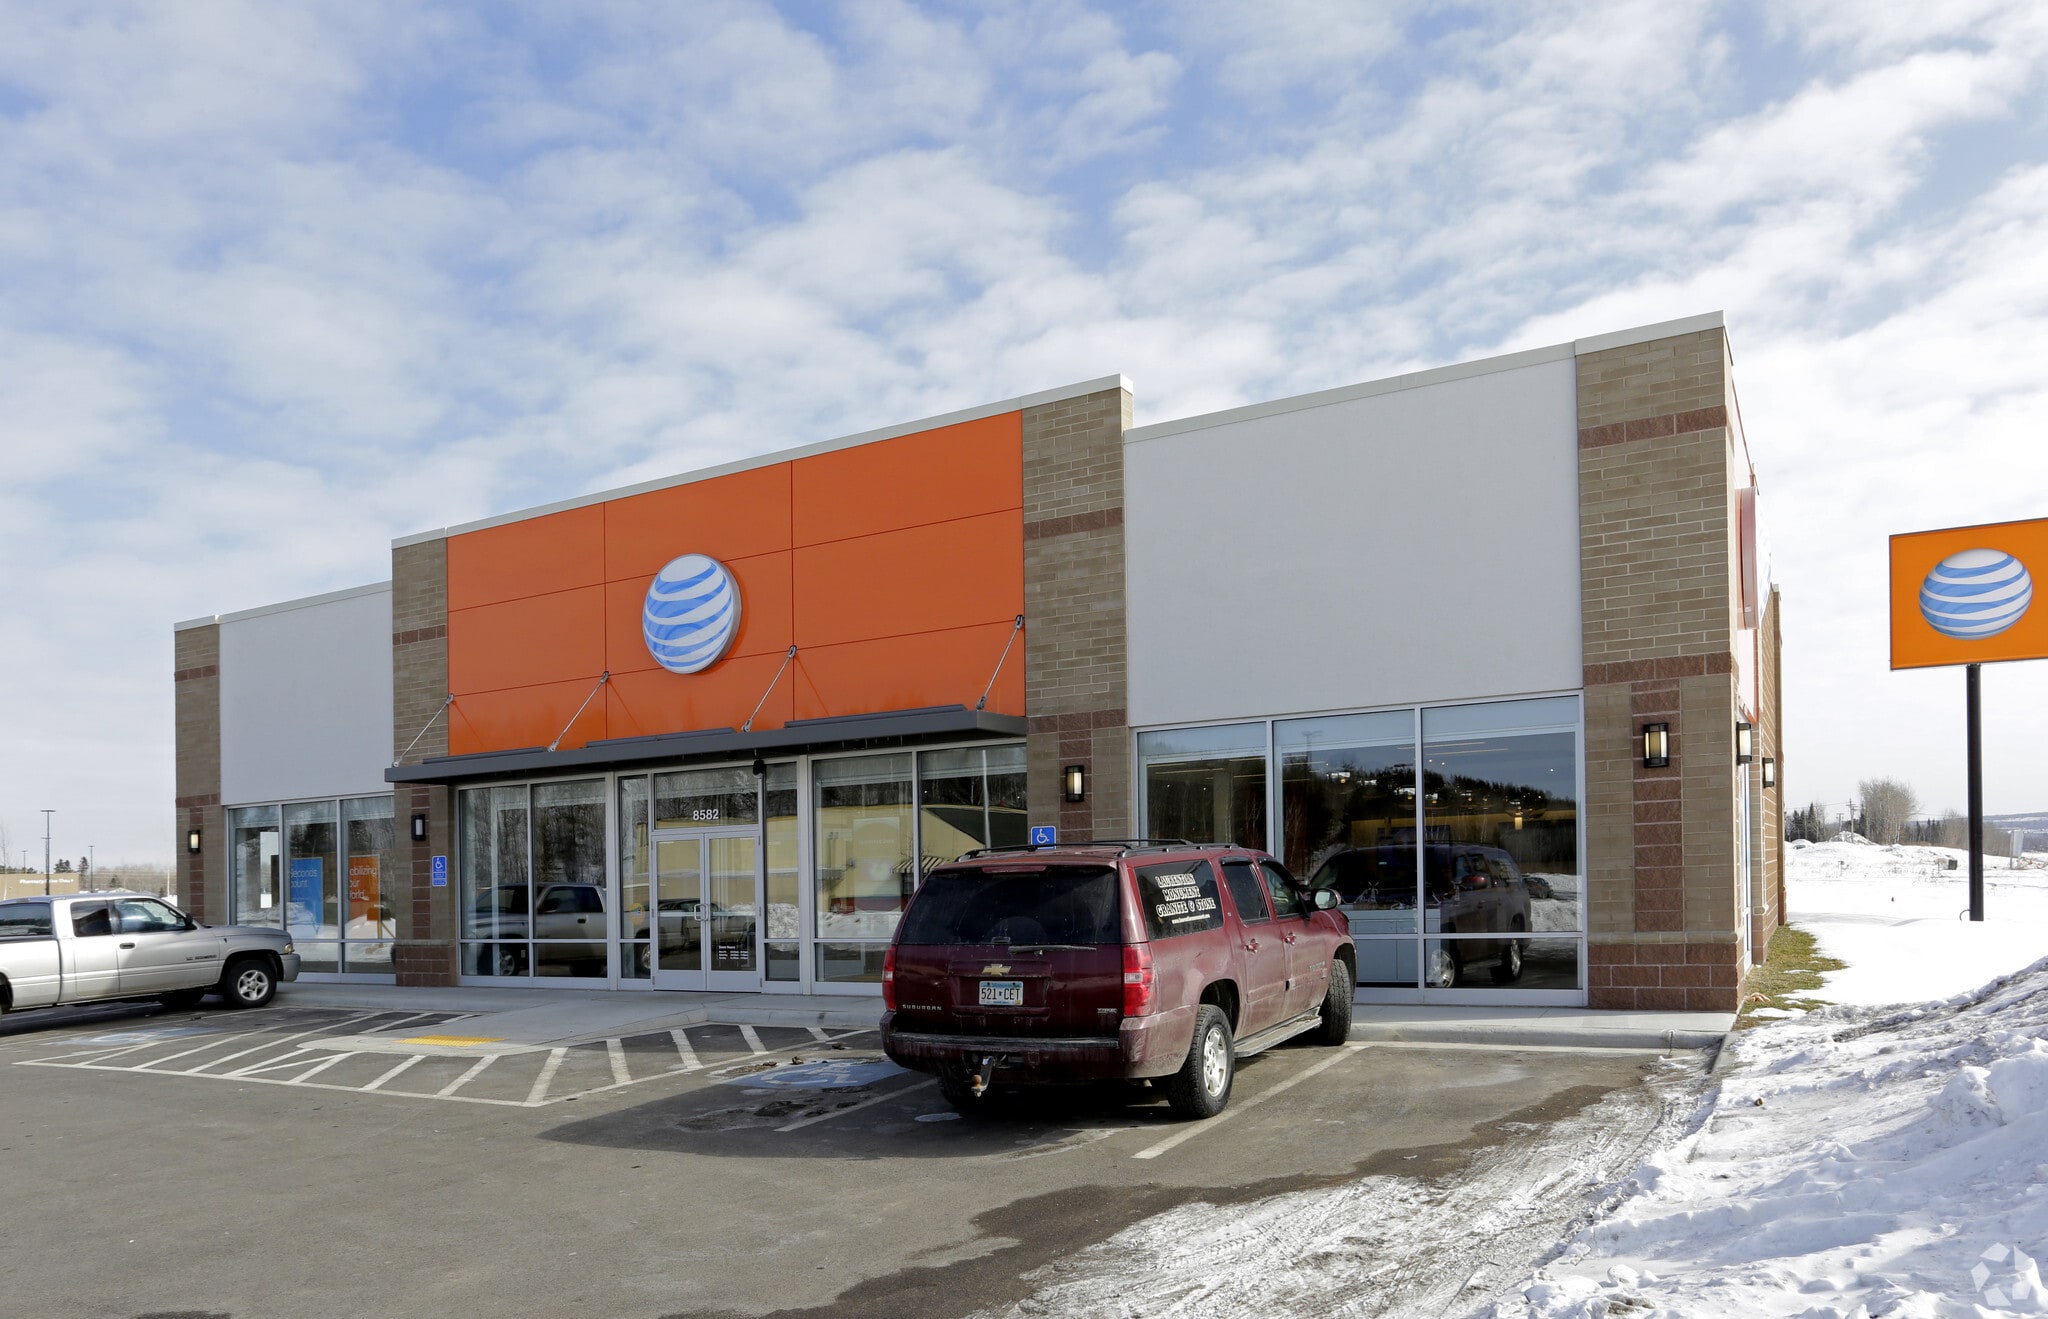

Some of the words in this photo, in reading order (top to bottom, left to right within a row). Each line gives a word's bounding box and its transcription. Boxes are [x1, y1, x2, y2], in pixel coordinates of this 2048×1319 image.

[692, 808, 719, 821] 8582
[350, 865, 377, 877] obilizing
[1155, 873, 1196, 888] LAURENTIAN
[1162, 885, 1201, 902] MONUMENT
[1156, 900, 1189, 918] GRANITE
[1195, 897, 1217, 912] STONE
[981, 987, 997, 1000] 521
[1003, 987, 1021, 1001] CET
